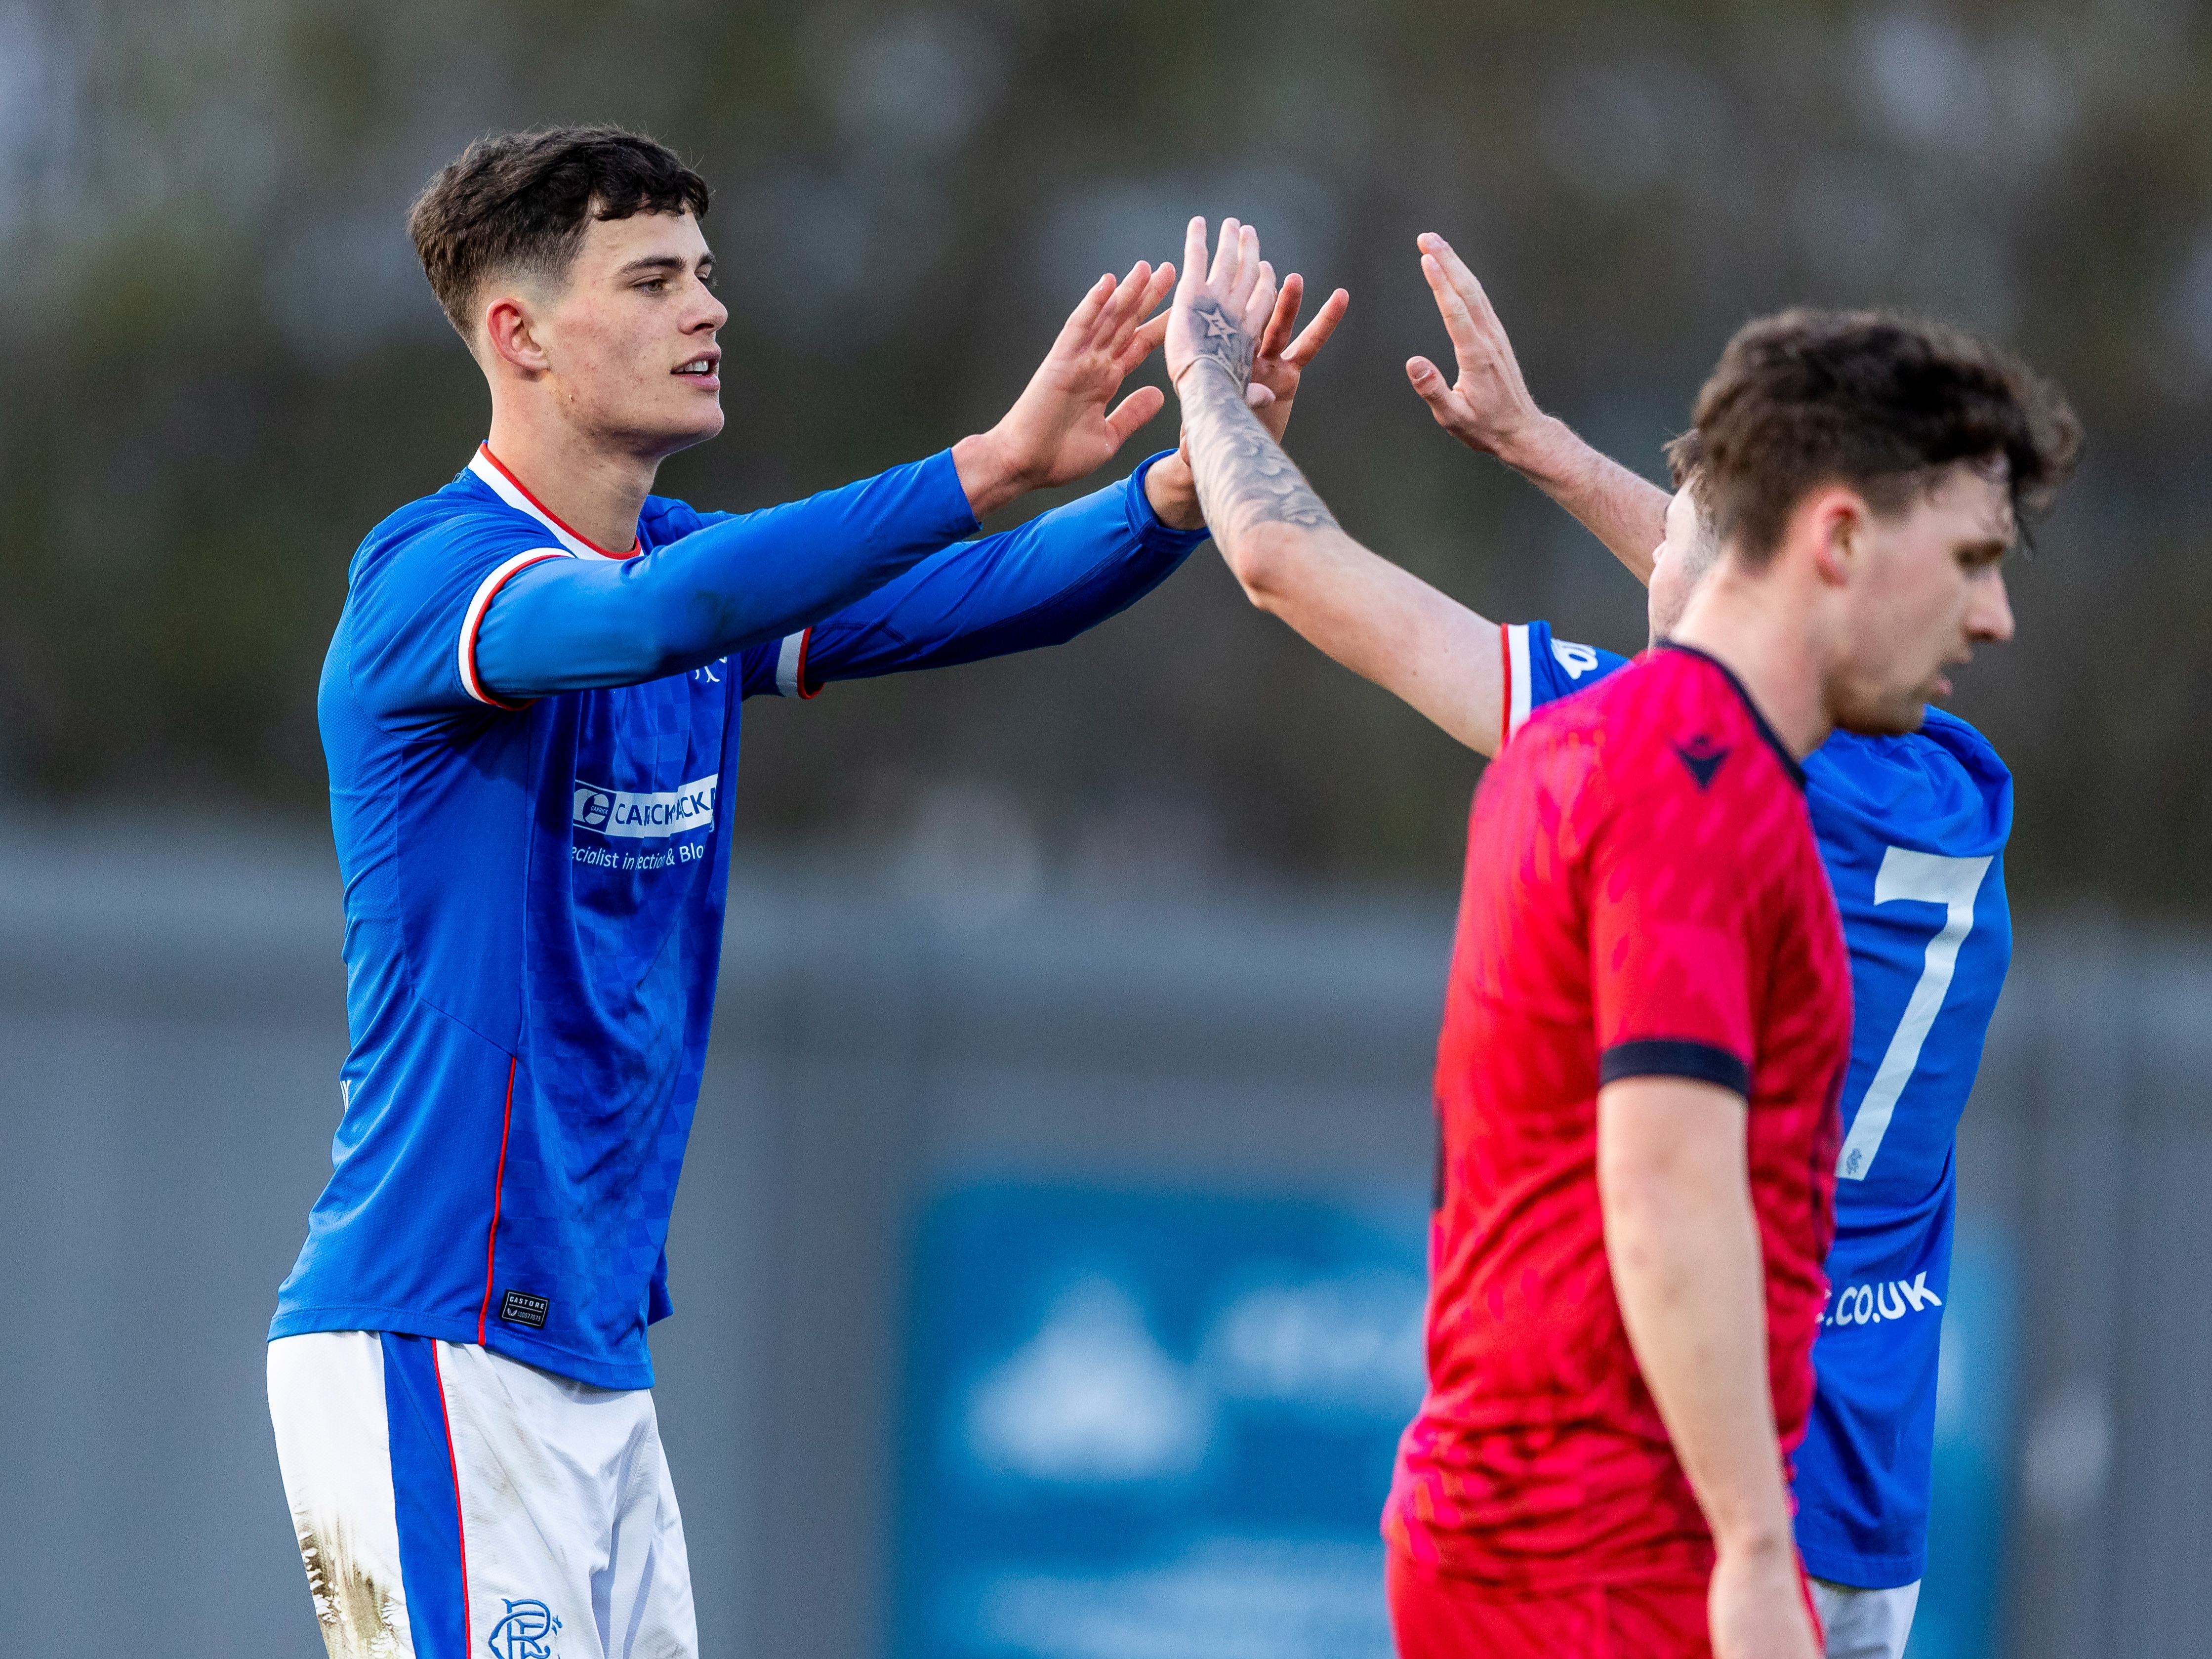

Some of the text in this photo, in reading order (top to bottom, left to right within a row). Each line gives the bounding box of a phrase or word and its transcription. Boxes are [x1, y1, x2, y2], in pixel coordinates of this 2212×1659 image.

[590, 806, 609, 815] CARRICK
[666, 848, 675, 866] &
[1833, 844, 1994, 1181] 7
[509, 1296, 545, 1309] CASTORE
[1815, 1271, 1942, 1327] .CO.UK
